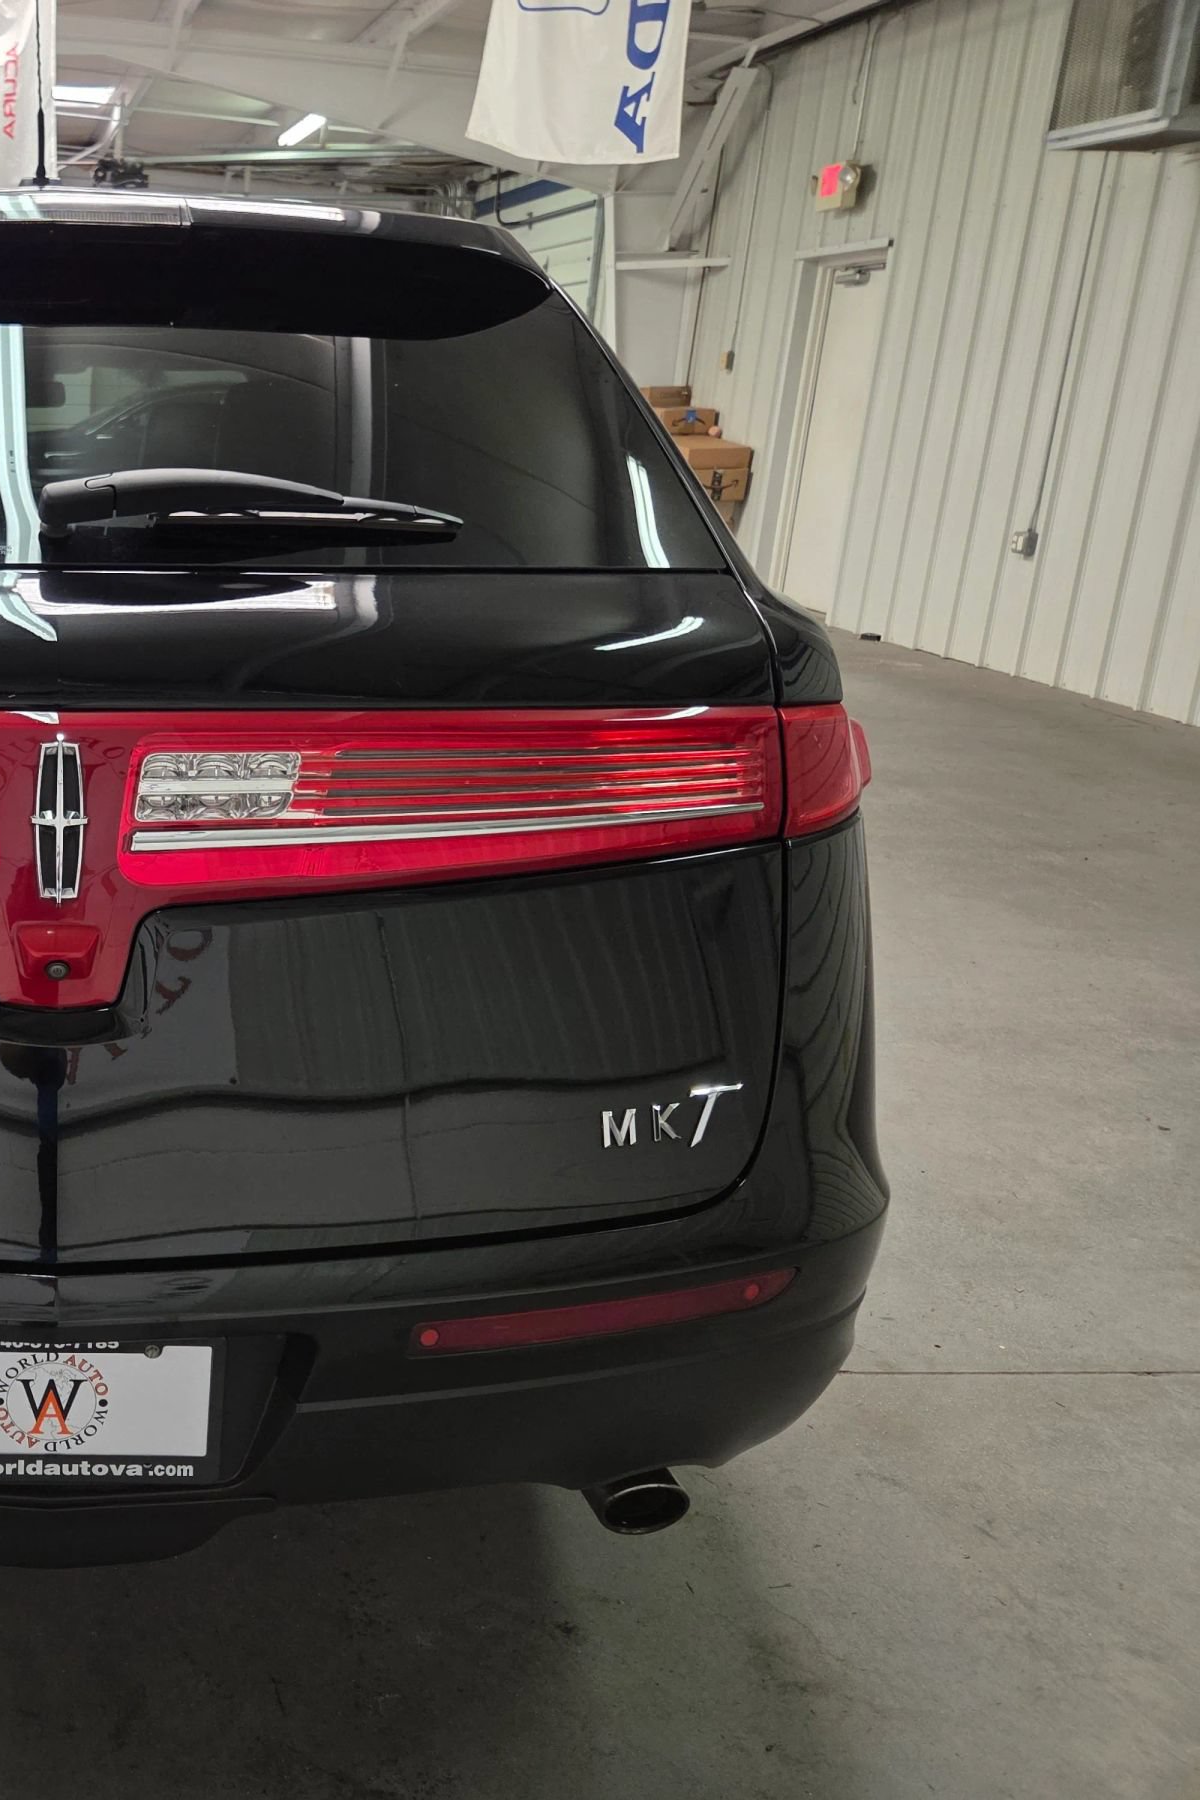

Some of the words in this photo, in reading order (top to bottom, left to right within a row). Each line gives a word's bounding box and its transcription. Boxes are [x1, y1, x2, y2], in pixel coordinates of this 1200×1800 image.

[602, 1080, 744, 1148] MKT
[62, 1354, 109, 1396] AUTO
[43, 1409, 109, 1453] WORLD
